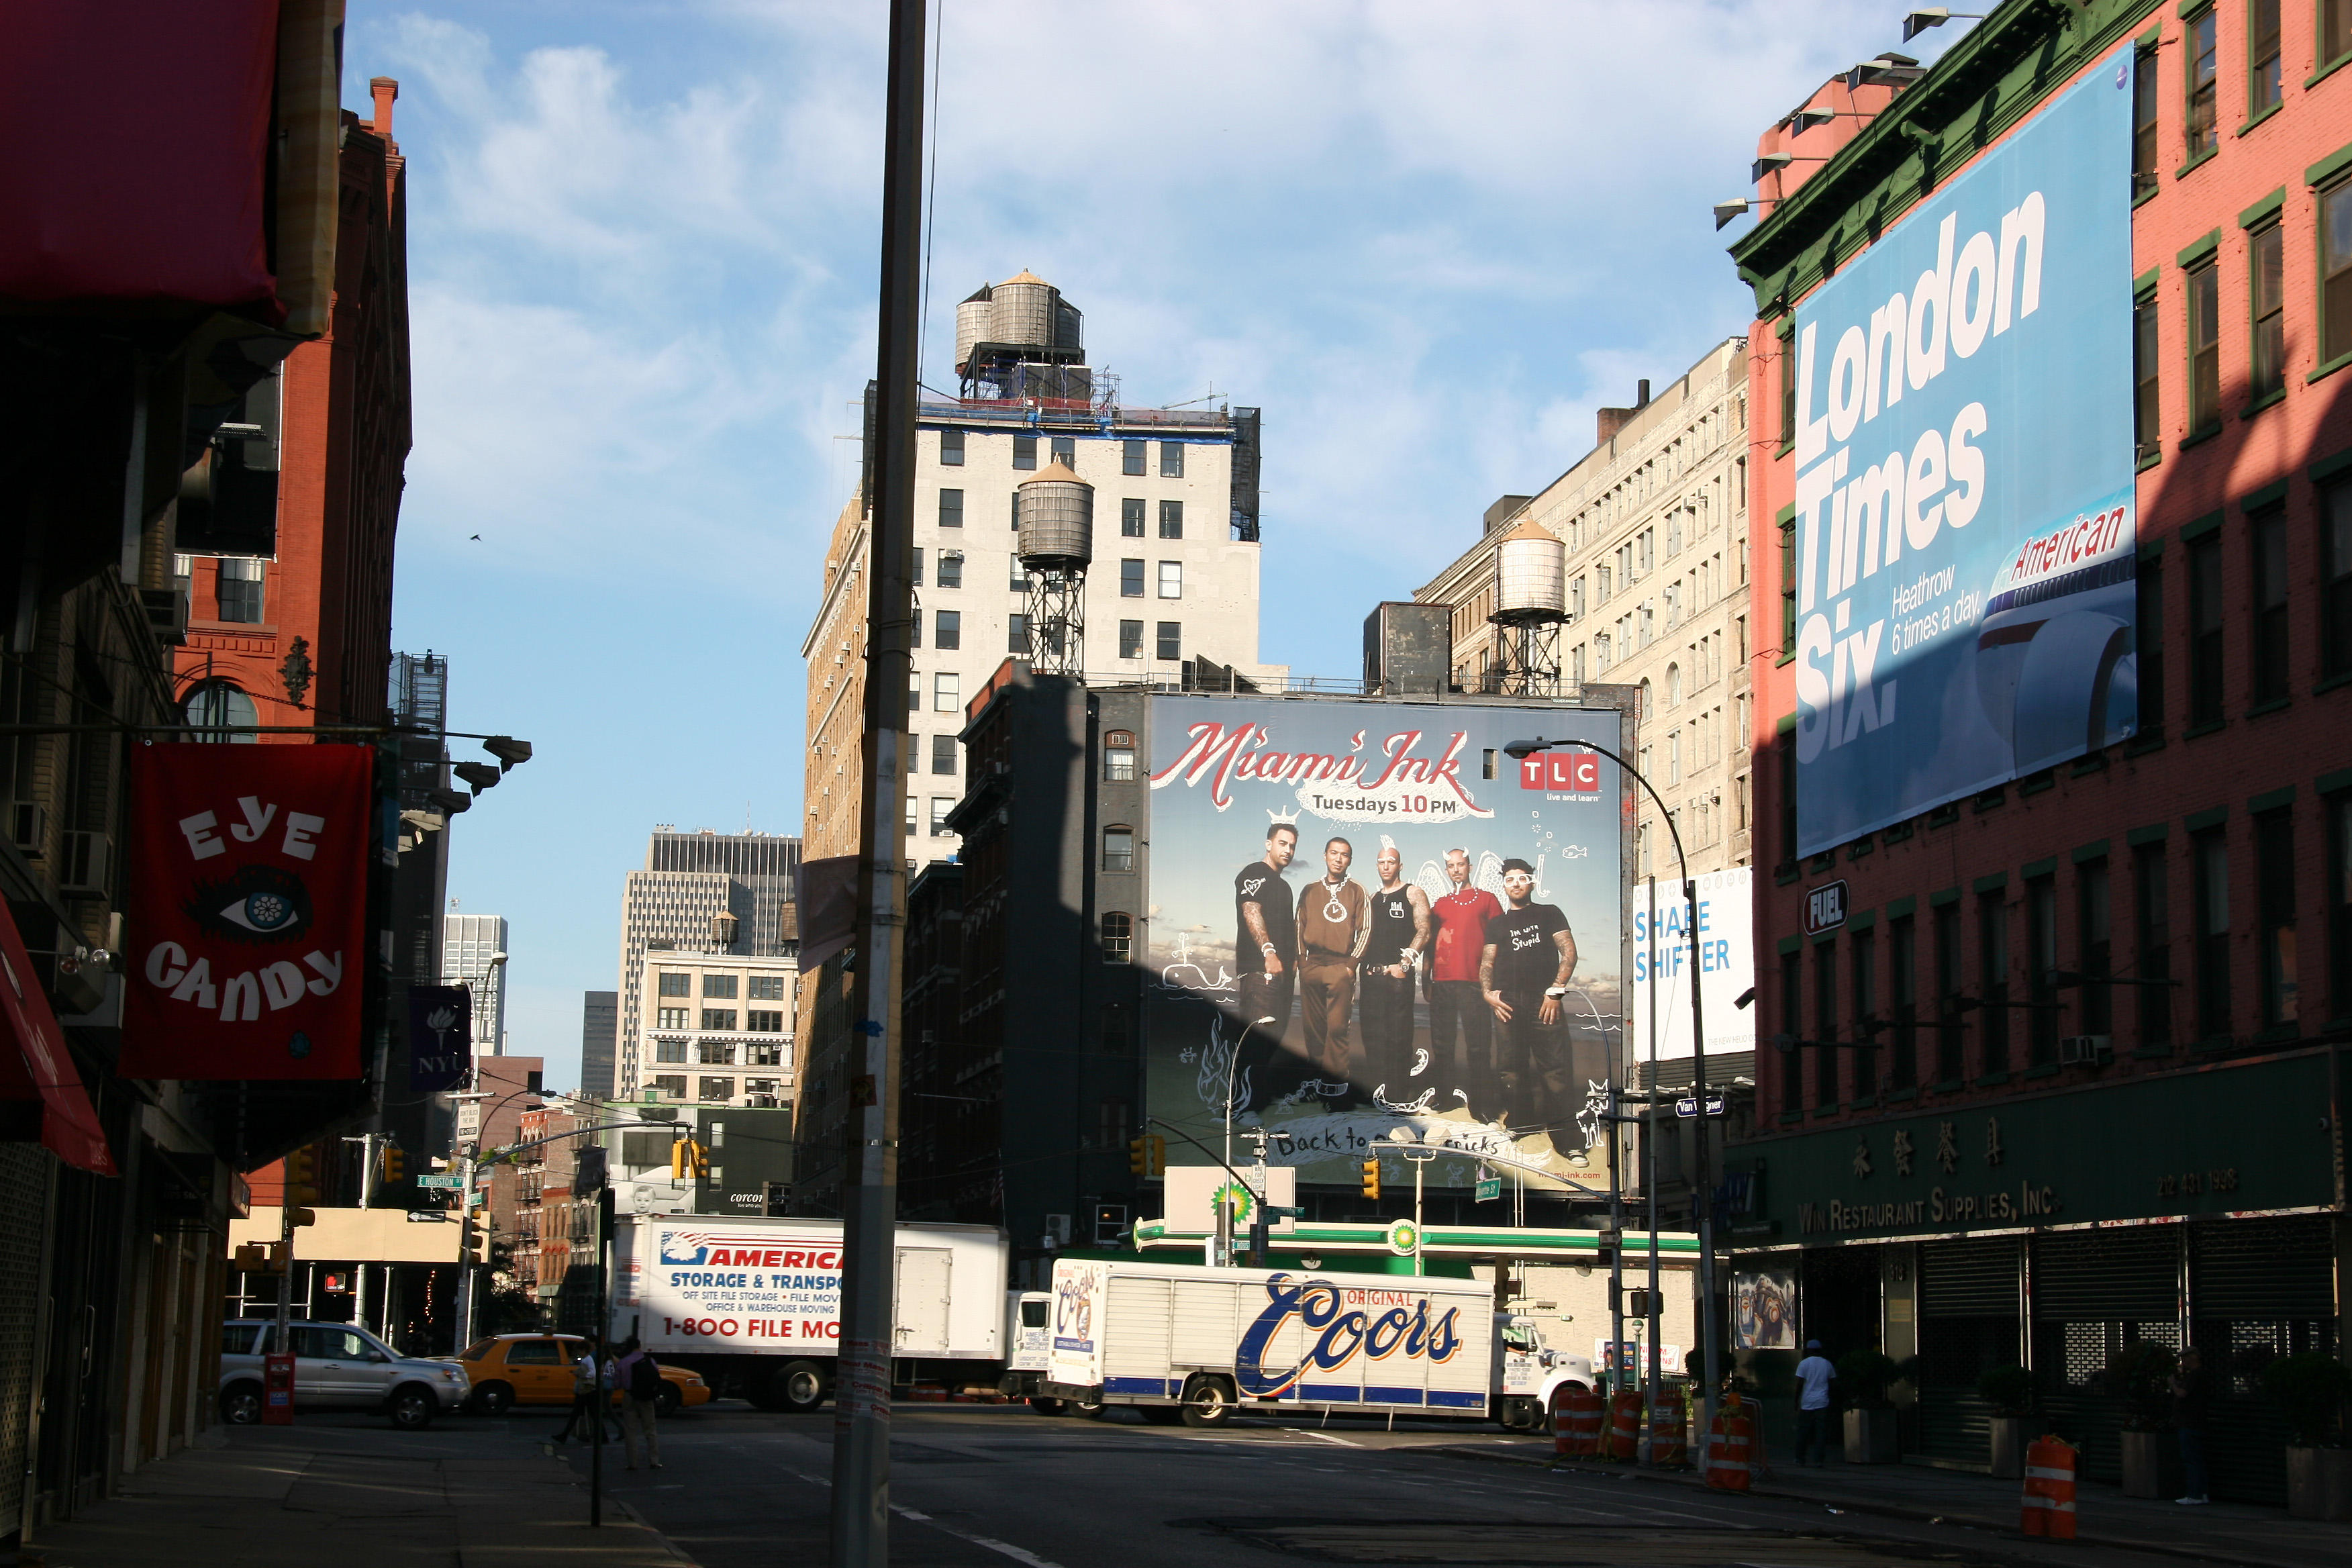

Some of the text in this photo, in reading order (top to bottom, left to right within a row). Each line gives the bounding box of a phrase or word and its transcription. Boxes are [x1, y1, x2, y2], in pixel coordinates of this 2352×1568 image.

[1796, 191, 2045, 469] London
[1796, 402, 1988, 616] Times
[2010, 505, 2126, 585] American
[1892, 565, 1955, 620] Heathrow
[1892, 590, 1980, 655] 6 times a day.
[1796, 599, 1897, 766] Six.
[1150, 722, 1495, 818] Miami Ink
[1524, 761, 1594, 783] TLC
[1312, 794, 1457, 814] Tuesdays 10 PM
[1810, 887, 1843, 929] FUEL
[1512, 933, 1540, 950] Stupid
[418, 1057, 464, 1074] NYU
[1679, 1101, 1693, 1112] Van
[1277, 1128, 1341, 1157] Back
[1349, 1127, 1367, 1150] to
[420, 1177, 423, 1185] E
[426, 1177, 454, 1186] HOUSTON
[1830, 1199, 1924, 1230] RESTAURANT
[1931, 1186, 2018, 1223] SUPPLIES,
[671, 1273, 746, 1288] STORAGE
[753, 1275, 763, 1288] &
[683, 1291, 698, 1300] OFF
[702, 1291, 718, 1300] SITE
[721, 1291, 736, 1300] FILE
[740, 1292, 778, 1302] STORAGE
[790, 1293, 809, 1302] FILE
[706, 1303, 835, 1314] OFFICE & WAREHOUSE MOVING
[1346, 1290, 1413, 1307] ORIGINAL
[664, 1317, 738, 1336] 1-800
[748, 1319, 792, 1337] FILE
[1235, 1273, 1463, 1397] Coors
